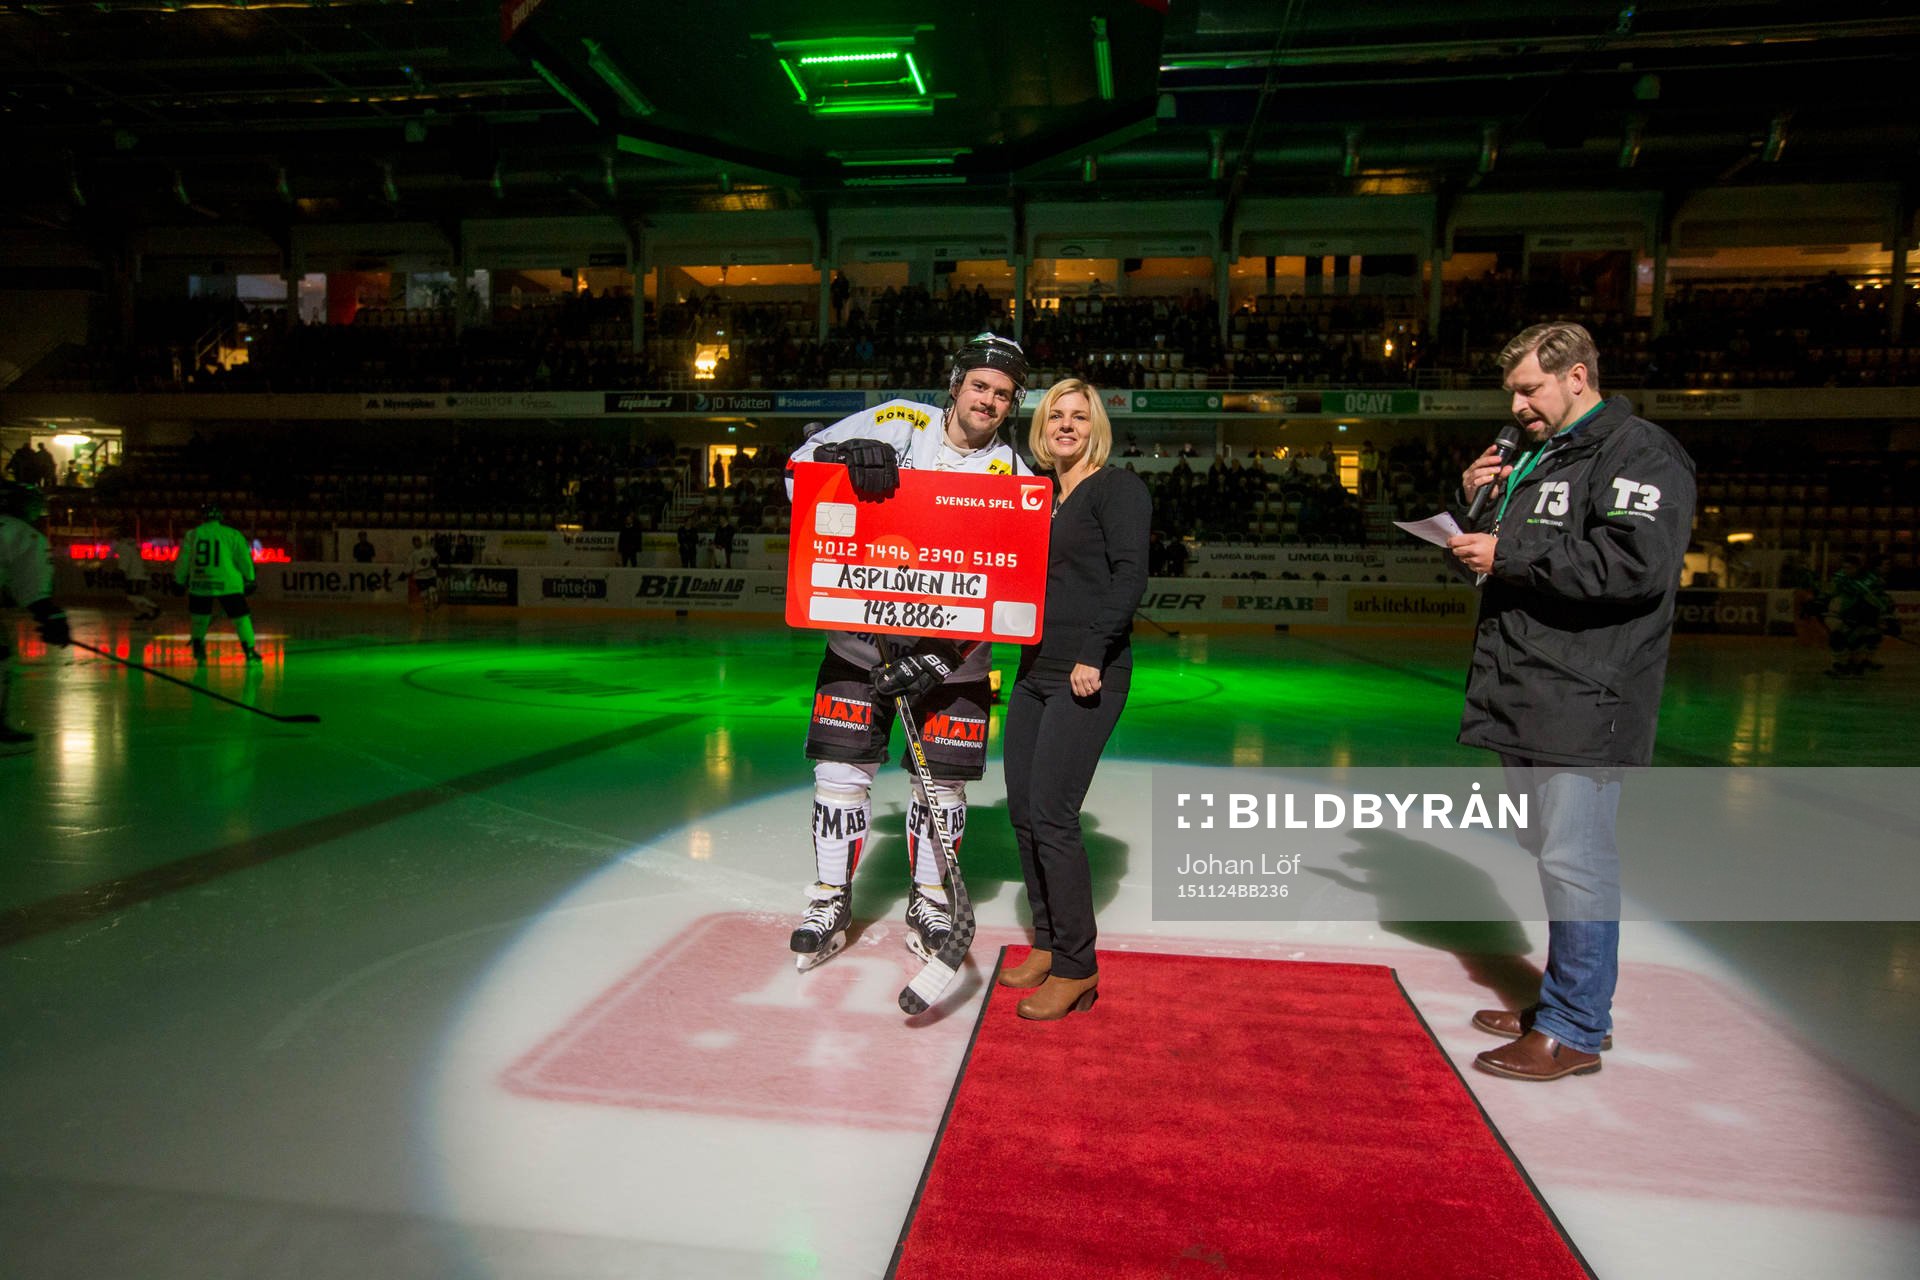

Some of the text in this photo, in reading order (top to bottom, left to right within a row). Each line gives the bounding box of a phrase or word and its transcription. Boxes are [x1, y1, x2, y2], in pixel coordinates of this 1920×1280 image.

[711, 398, 724, 411] JD
[1344, 392, 1392, 413] OCAY!
[935, 495, 1016, 510] SVENSKA SPEL
[1533, 481, 1570, 516] T3
[1612, 477, 1661, 511] T3
[195, 539, 220, 567] 91
[813, 540, 1017, 568] 4012 7496 2390 5185
[282, 569, 394, 593] ume.net
[724, 579, 746, 592] AB
[838, 563, 982, 597] ASPLÖVEN HC
[1236, 596, 1314, 611] PEAB
[1353, 596, 1466, 616] arkitektkopia
[814, 693, 872, 725] MAXI
[923, 713, 985, 741] MAXI
[846, 809, 866, 836] AB
[952, 810, 966, 835] AB
